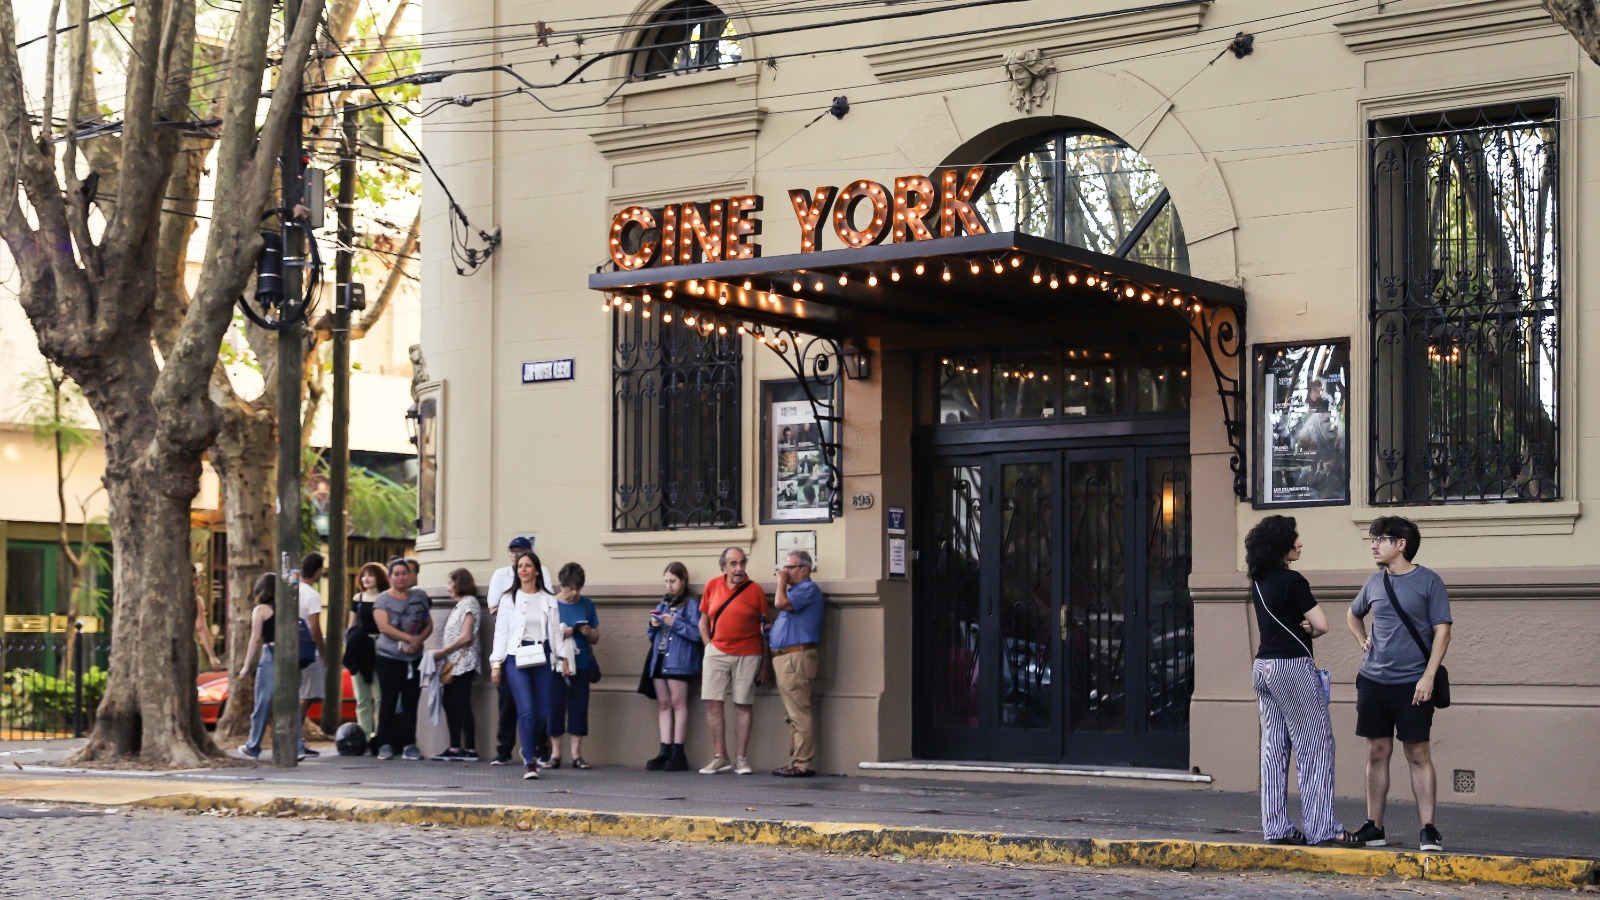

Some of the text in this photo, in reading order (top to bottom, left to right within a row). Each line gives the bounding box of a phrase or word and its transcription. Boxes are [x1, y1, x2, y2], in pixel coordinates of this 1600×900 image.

[609, 166, 991, 271] CINE YORK
[852, 495, 871, 506] 895
